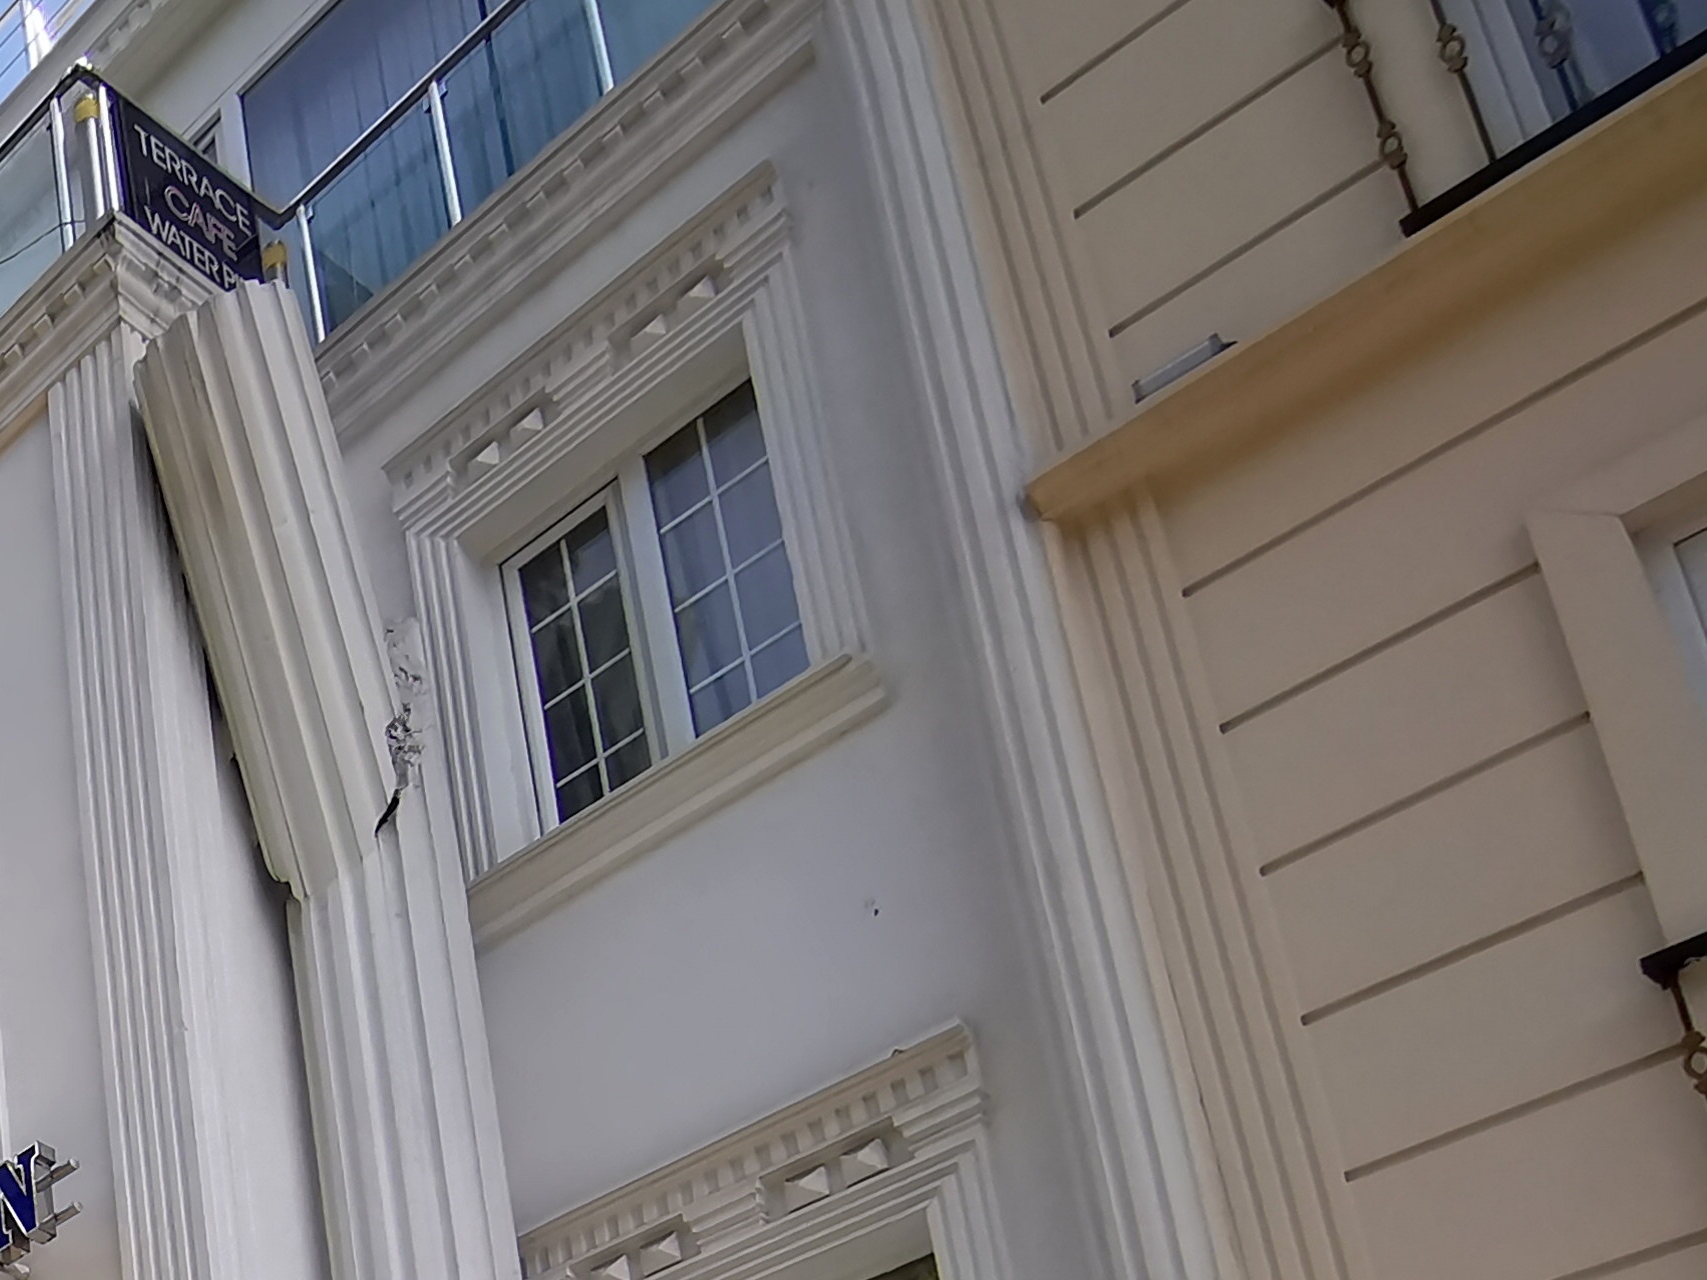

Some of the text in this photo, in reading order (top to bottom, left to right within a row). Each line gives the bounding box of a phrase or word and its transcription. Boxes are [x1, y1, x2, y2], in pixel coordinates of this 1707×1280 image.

[134, 124, 252, 237] TERRACE
[144, 205, 220, 284] WATER
[164, 185, 237, 261] CAFE
